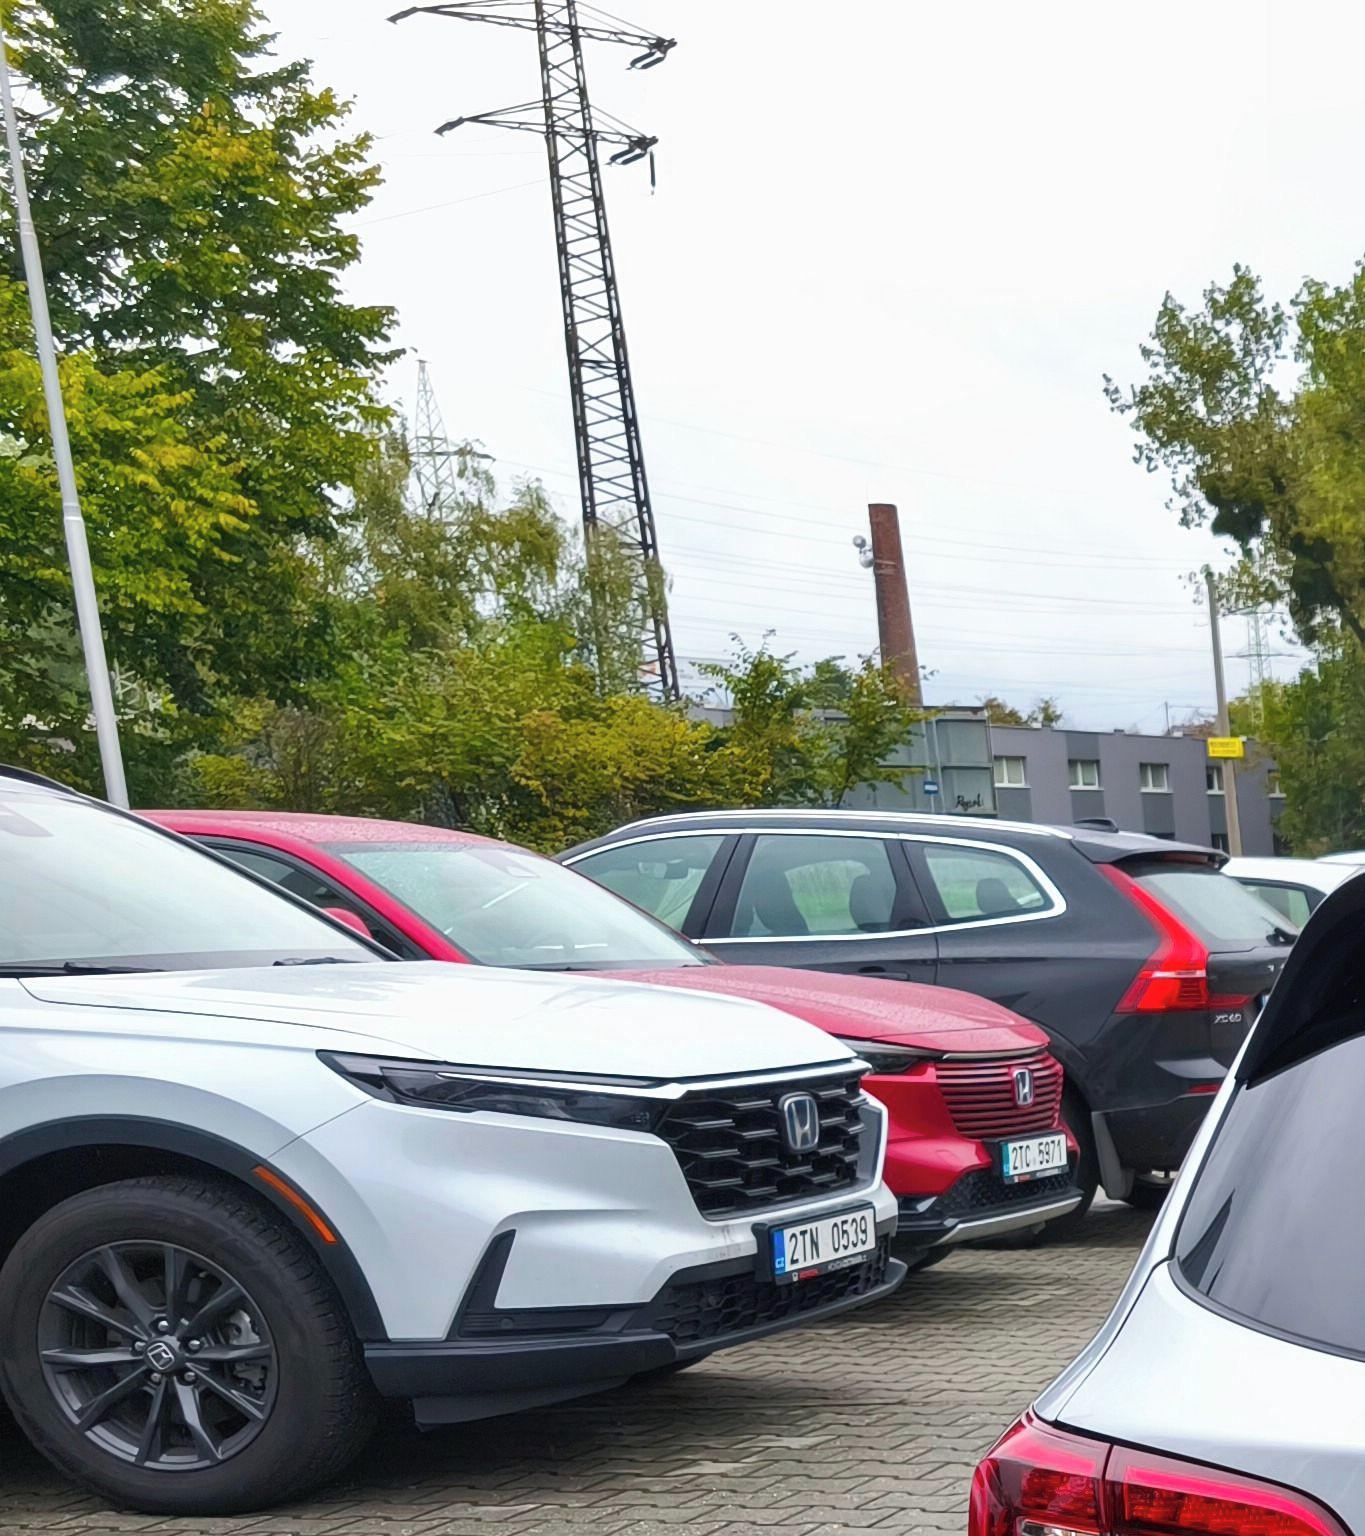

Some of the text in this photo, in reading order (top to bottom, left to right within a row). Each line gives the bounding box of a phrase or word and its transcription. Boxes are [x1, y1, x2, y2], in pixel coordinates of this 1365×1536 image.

[1012, 1144, 1031, 1170] 2TC
[1038, 1138, 1062, 1165] 5971
[789, 1226, 820, 1265] 2TN
[831, 1215, 868, 1253] 0539
